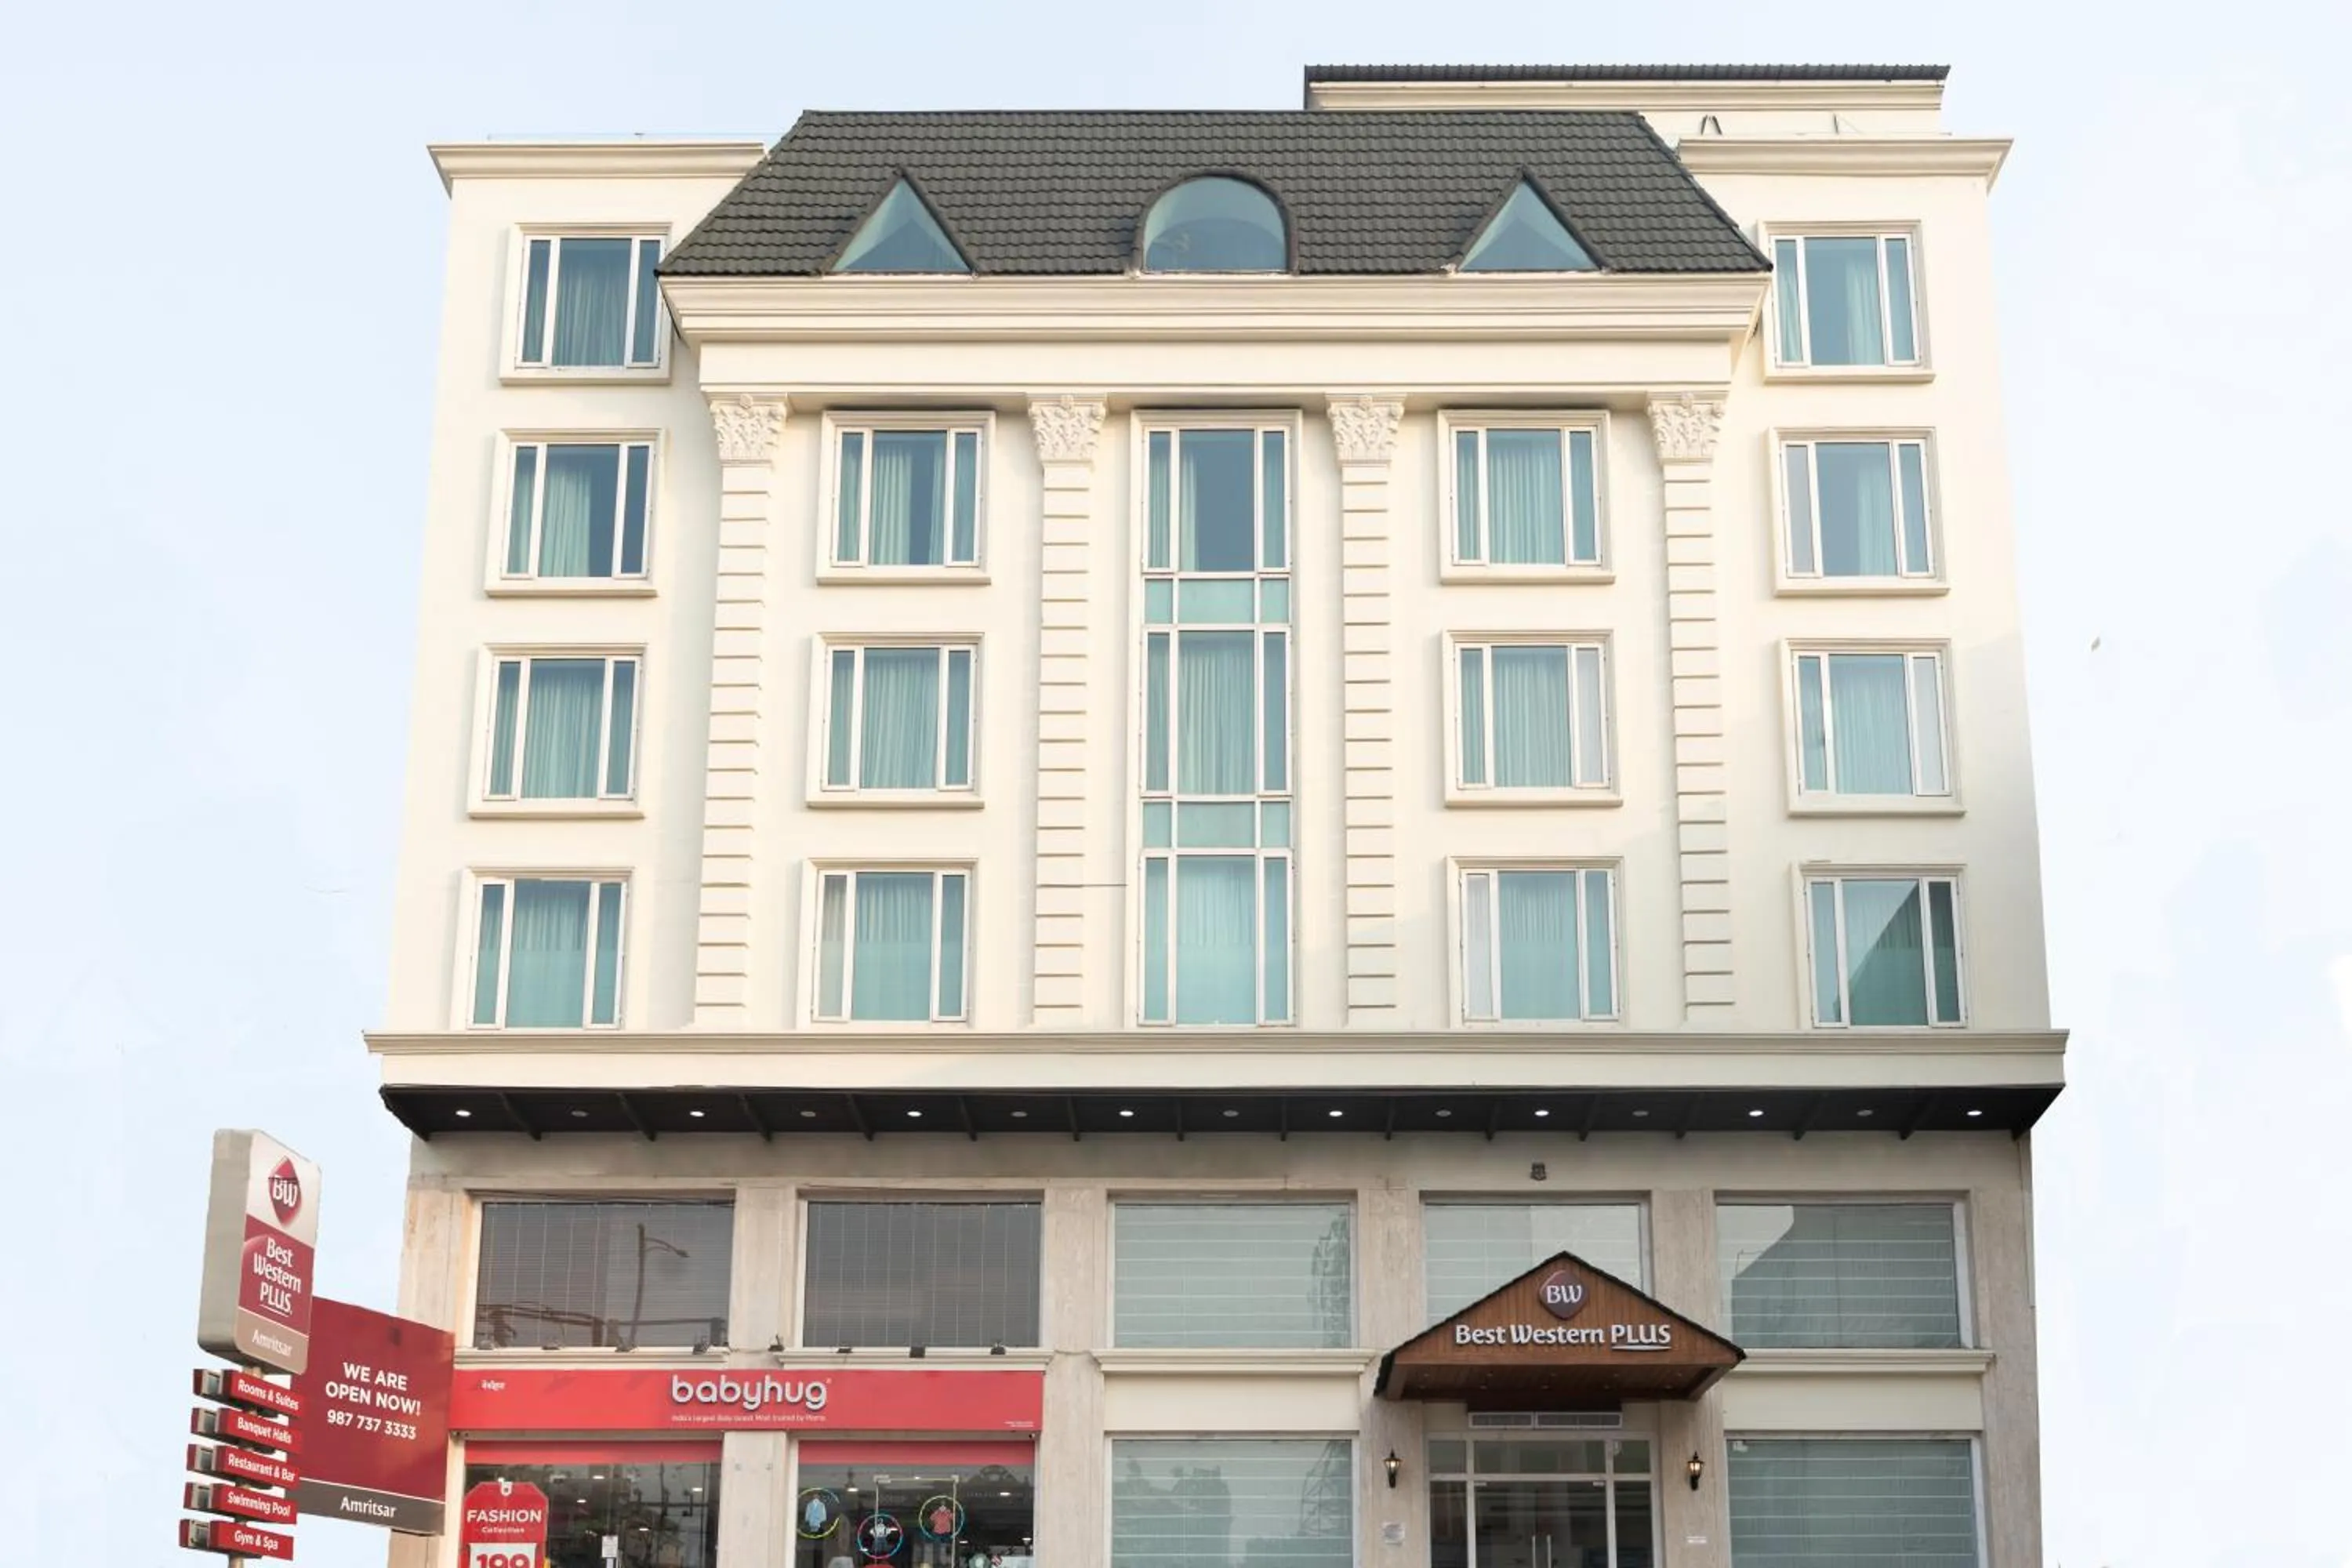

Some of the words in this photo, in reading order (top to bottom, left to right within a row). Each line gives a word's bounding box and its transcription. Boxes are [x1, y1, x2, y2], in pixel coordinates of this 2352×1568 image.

[273, 1175, 299, 1207] BW
[266, 1237, 293, 1267] Best
[253, 1252, 301, 1294] Western
[260, 1282, 292, 1313] PLUS
[1546, 1284, 1582, 1305] BW
[252, 1329, 293, 1357] Amritsar
[1455, 1323, 1506, 1345] Best
[1509, 1323, 1605, 1345] Western
[1610, 1323, 1671, 1345] PLUS
[343, 1362, 370, 1382] WE
[375, 1370, 408, 1391] ARE
[238, 1379, 267, 1399] Rooms
[268, 1390, 274, 1402] &
[276, 1392, 299, 1410] Suites
[325, 1381, 371, 1405] OPEN
[376, 1393, 421, 1416] NOW!
[671, 1374, 827, 1410] babyhug
[238, 1417, 270, 1440] Banquet
[273, 1428, 292, 1444] Halls
[327, 1409, 353, 1426] 987
[357, 1414, 381, 1432] 737
[385, 1420, 417, 1439] 3333
[228, 1454, 273, 1475] Restaurant
[274, 1465, 279, 1478] &
[281, 1467, 296, 1482] Bar
[227, 1491, 270, 1515] Swimming
[273, 1501, 291, 1517] Pool
[340, 1496, 397, 1518] Amritsar
[466, 1509, 542, 1523] FASHION
[234, 1530, 254, 1547] Gym
[255, 1534, 261, 1547] &
[263, 1537, 278, 1551] Spa
